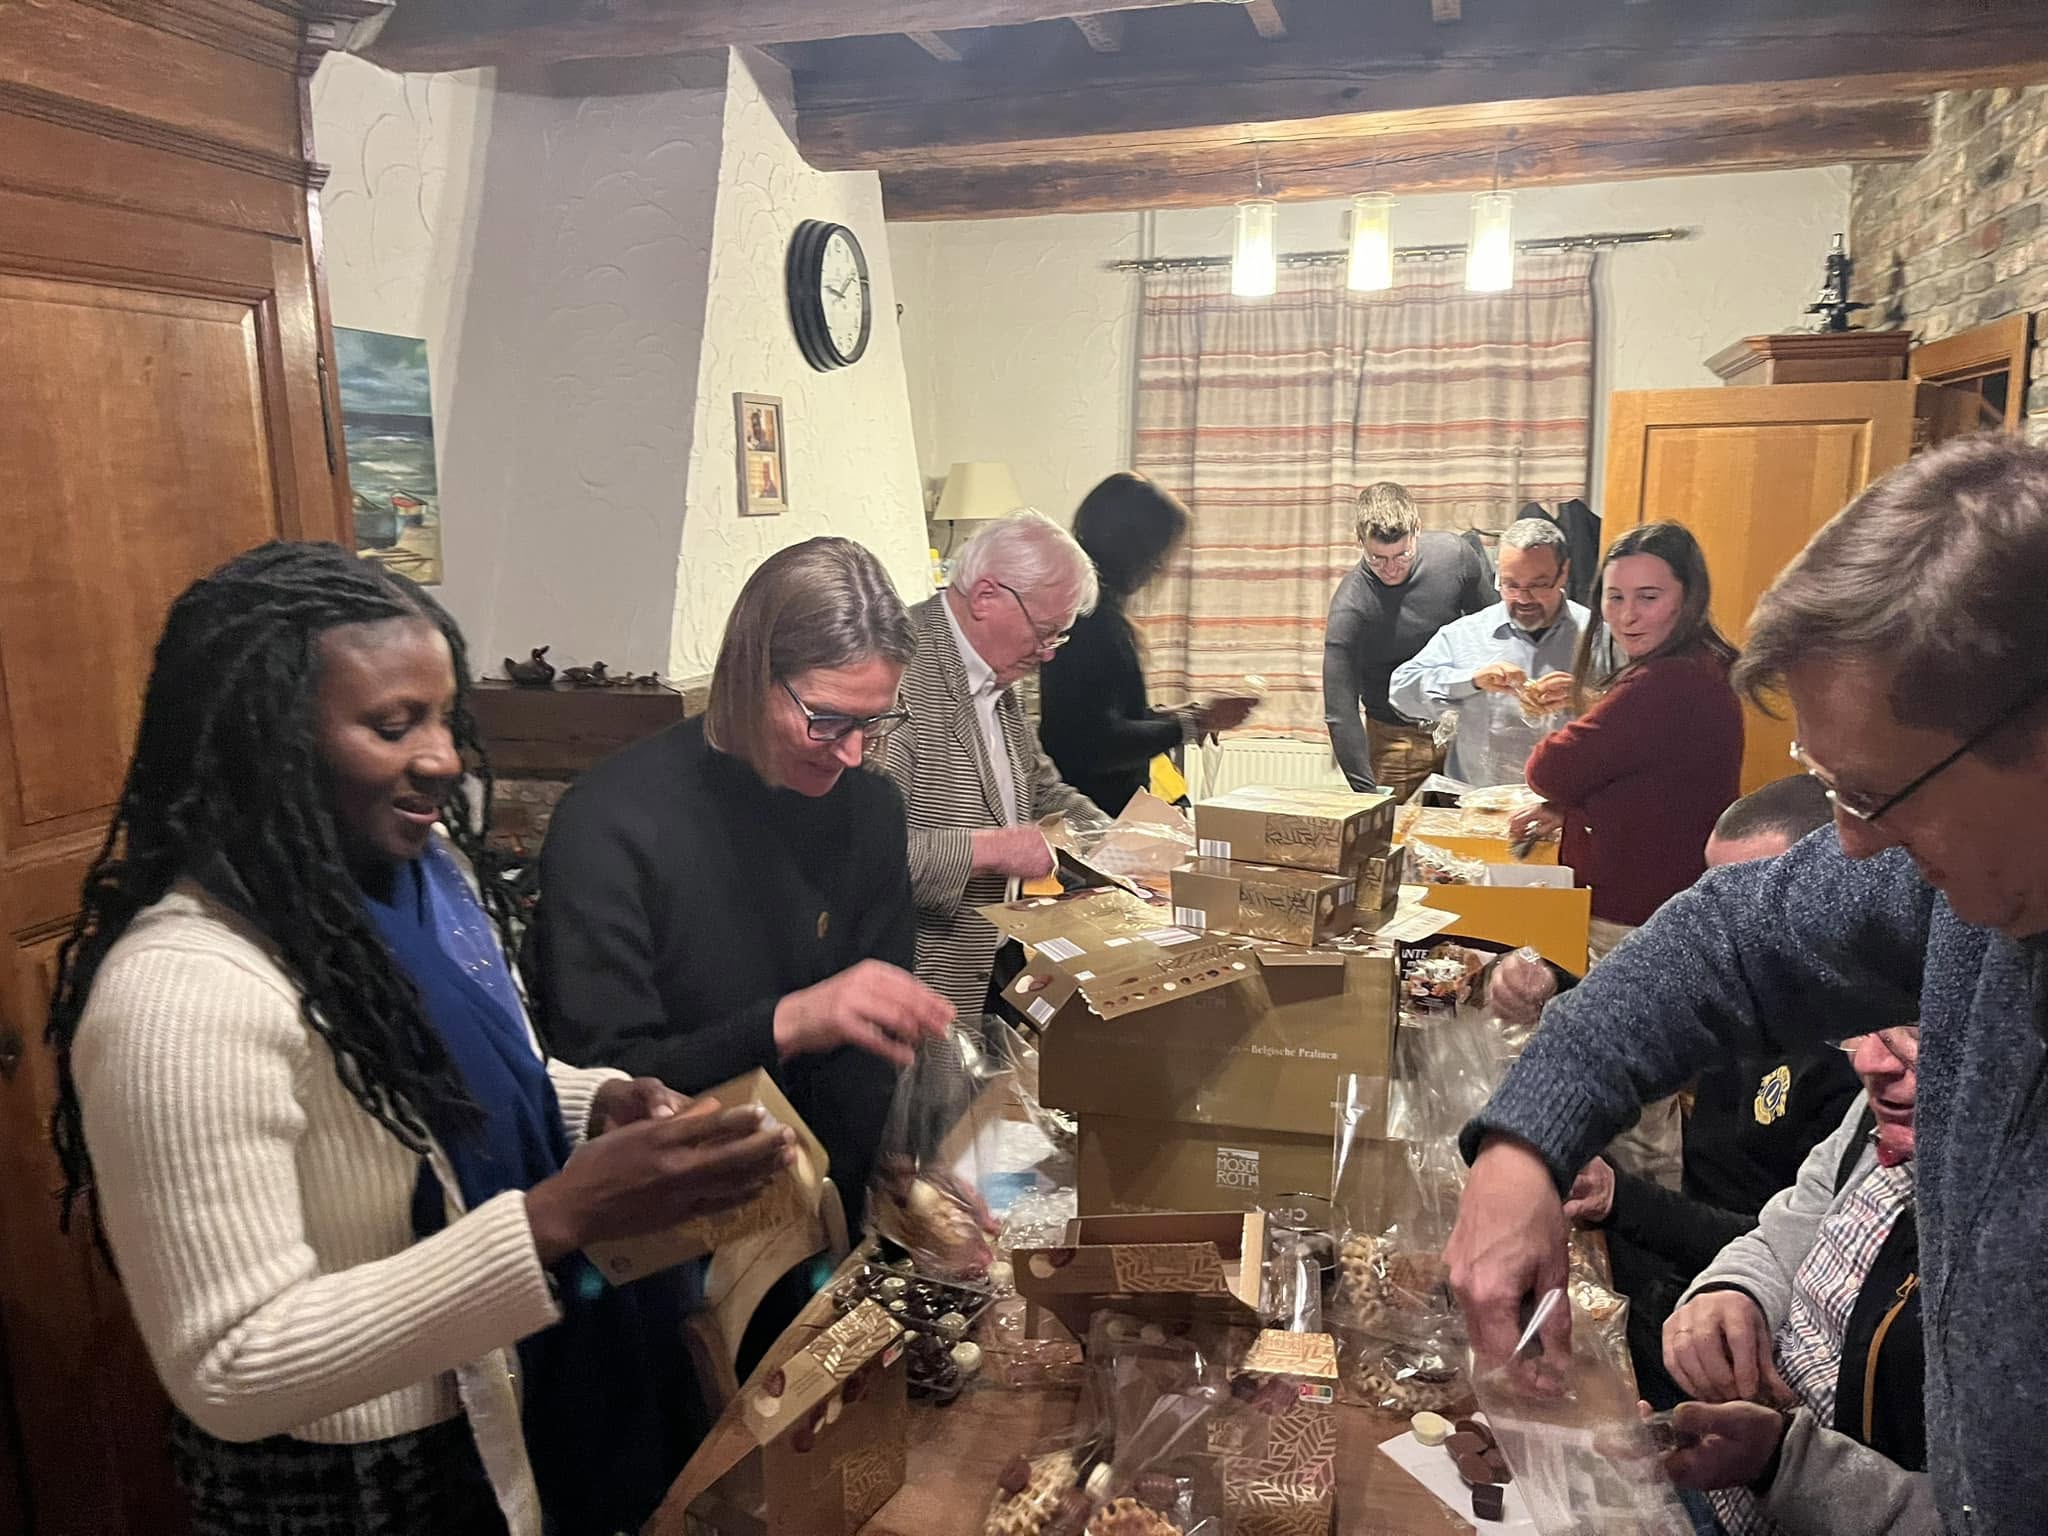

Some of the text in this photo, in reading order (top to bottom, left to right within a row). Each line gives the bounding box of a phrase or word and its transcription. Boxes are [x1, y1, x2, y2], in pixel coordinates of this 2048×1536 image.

[1251, 1044, 1296, 1057] Belgische
[1298, 1047, 1338, 1060] Pralinen
[1216, 1156, 1259, 1186] MOSER ROTH
